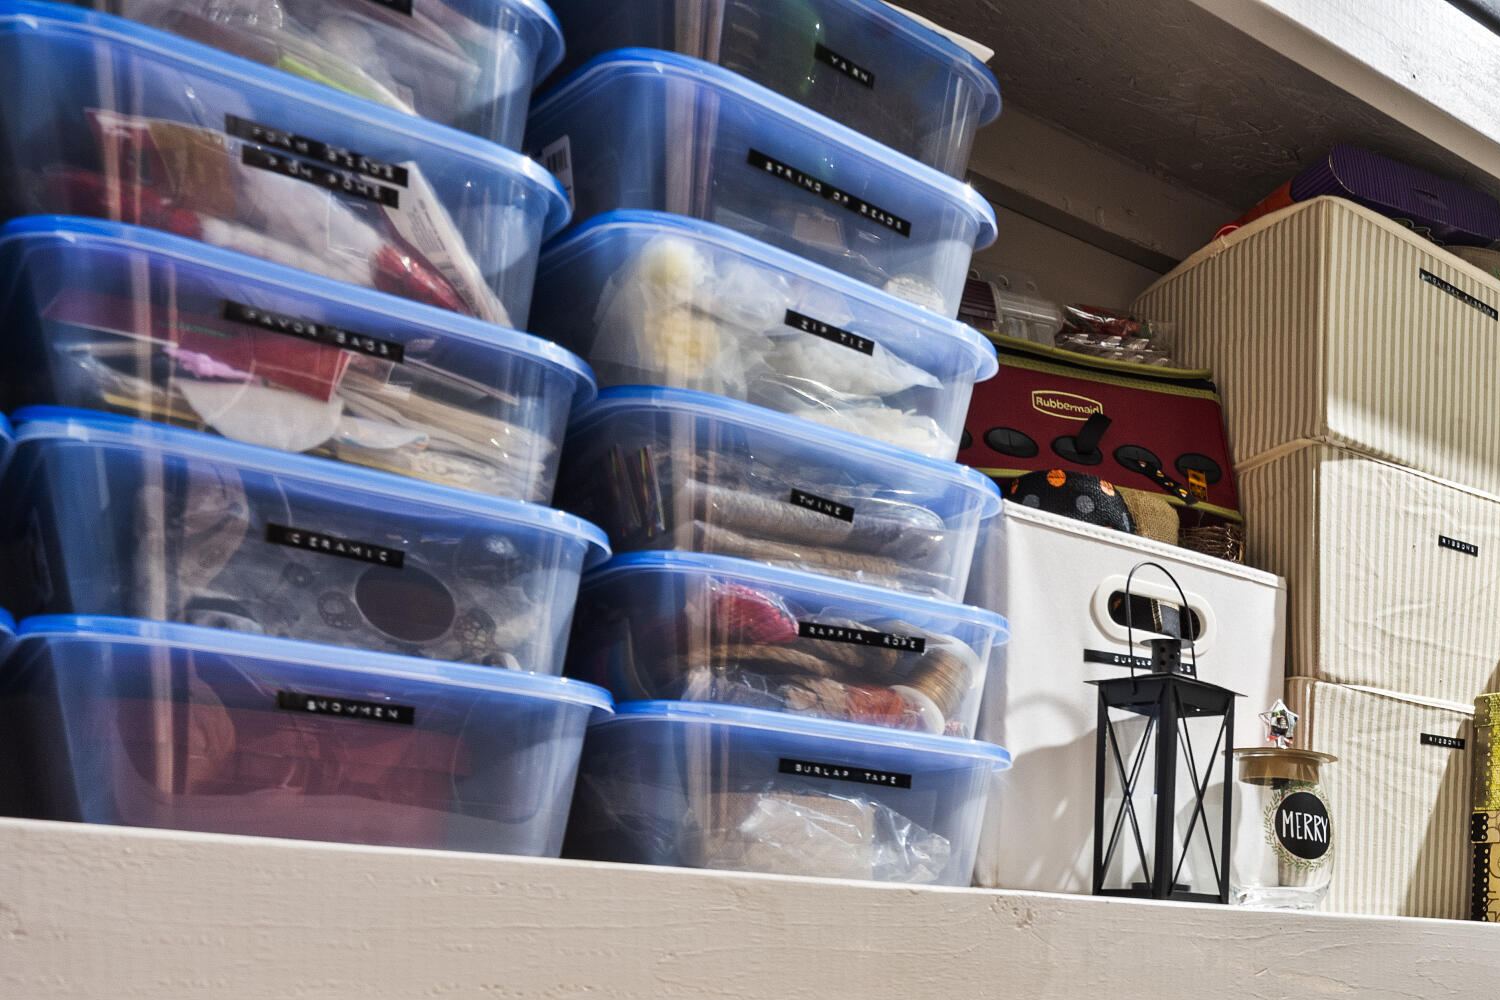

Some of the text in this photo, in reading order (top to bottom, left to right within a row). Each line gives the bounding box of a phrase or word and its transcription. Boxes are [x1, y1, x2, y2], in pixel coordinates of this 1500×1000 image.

[831, 55, 868, 83] YARN
[765, 161, 902, 230] STRING OF BEADS
[248, 309, 389, 354] FAVOR BAGS
[801, 319, 864, 349] ZIP TIE
[1035, 396, 1100, 415] Rubbermaid
[799, 495, 841, 516] TWINE
[291, 533, 388, 562] CERAMIC
[1442, 537, 1475, 553] RIBBONS
[883, 634, 916, 649] ROPE
[306, 700, 399, 719] SNOWMEN
[1429, 736, 1461, 747] RIBBONS
[795, 763, 897, 784] BURLAP TAPE
[1282, 809, 1328, 844] MERRY
